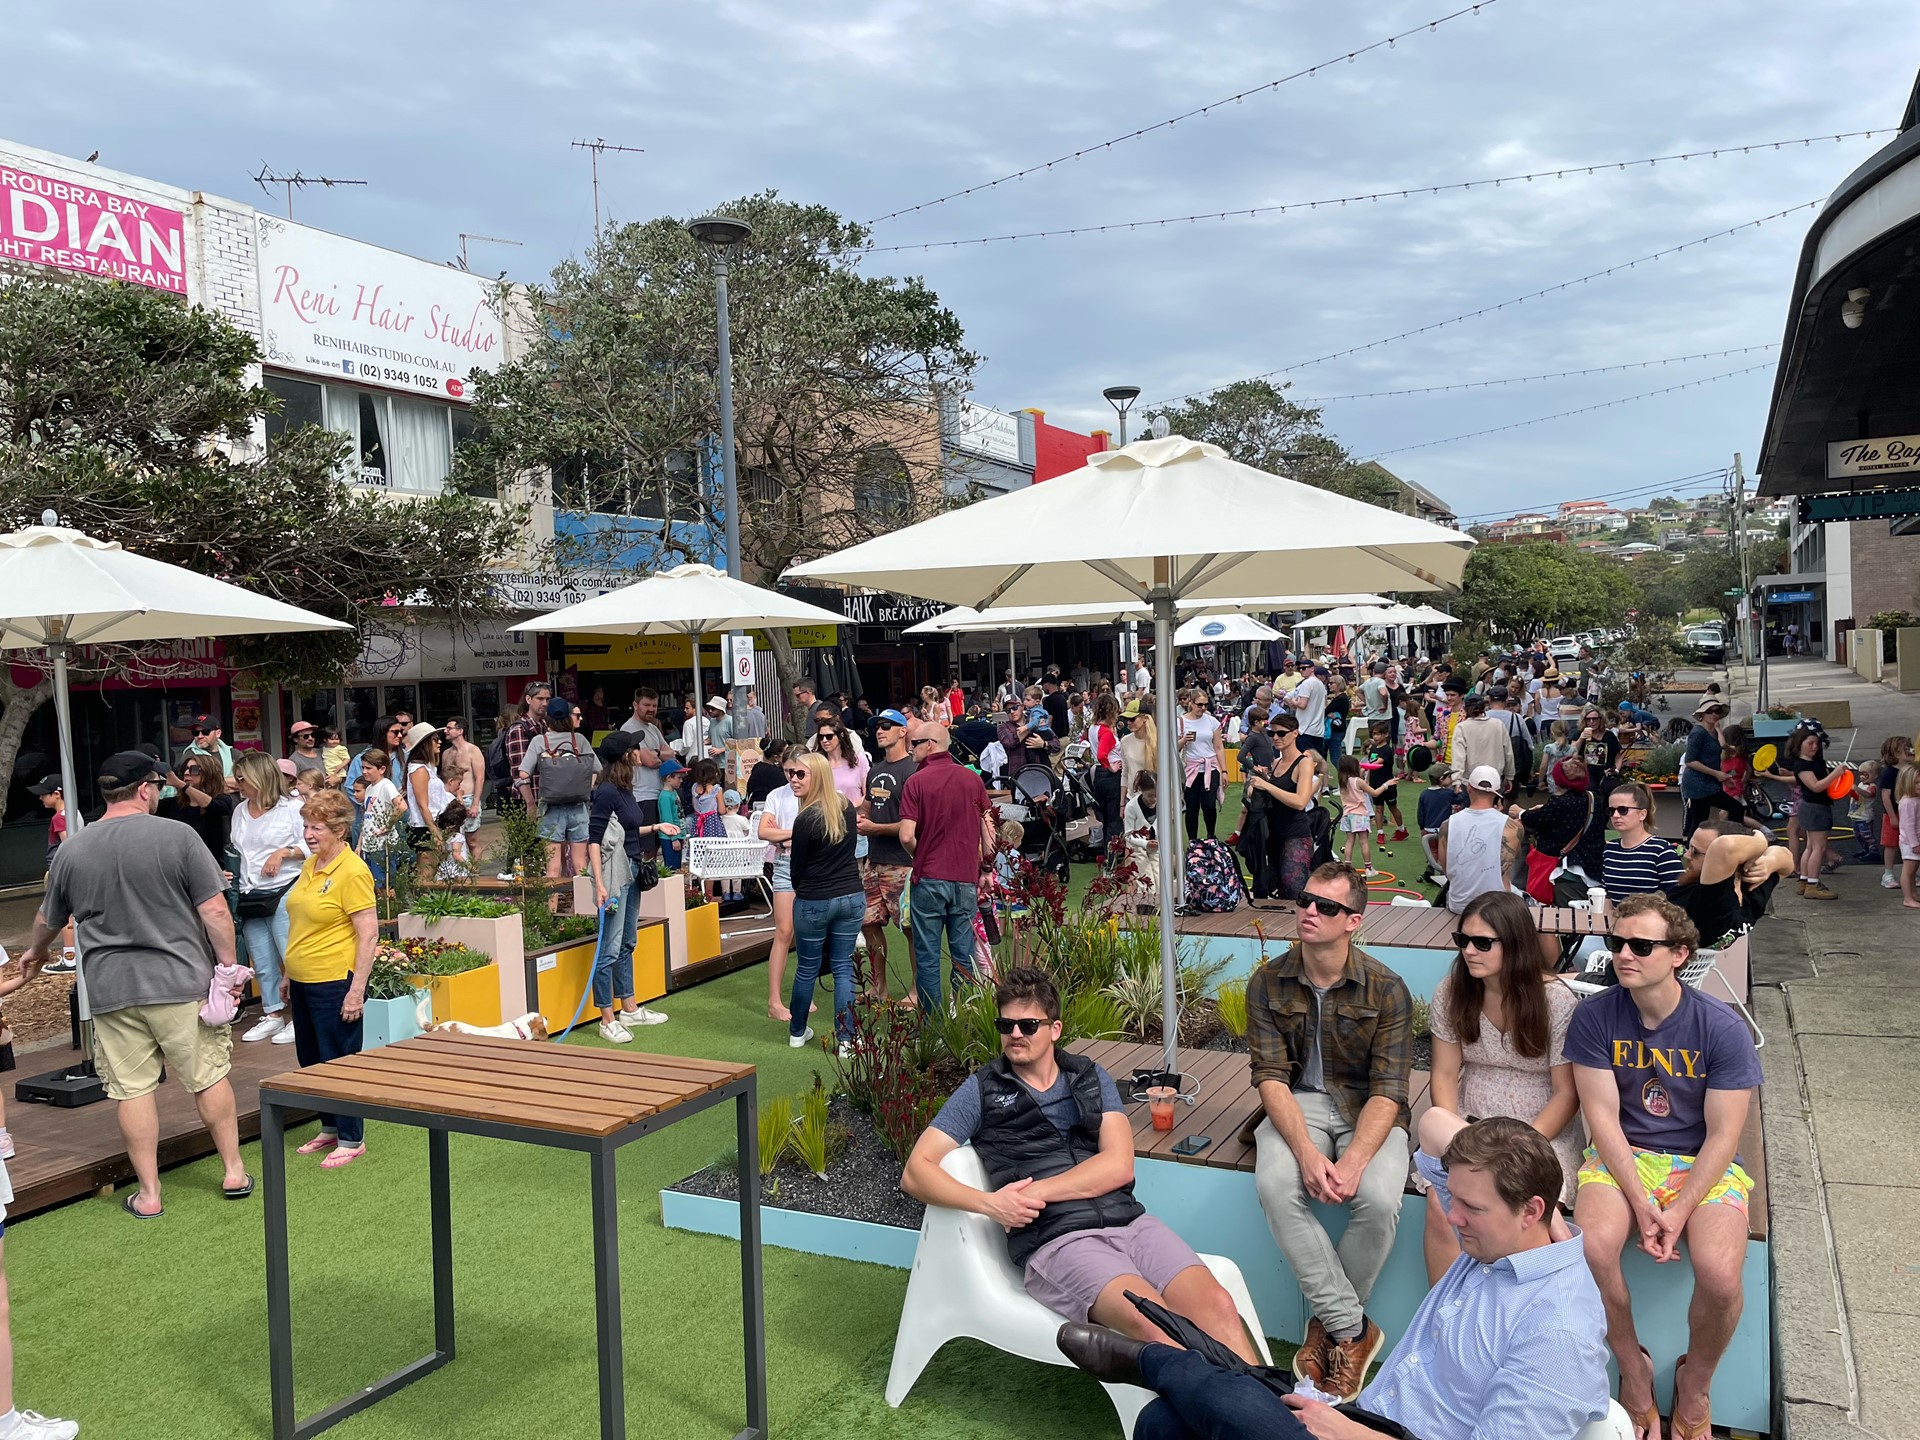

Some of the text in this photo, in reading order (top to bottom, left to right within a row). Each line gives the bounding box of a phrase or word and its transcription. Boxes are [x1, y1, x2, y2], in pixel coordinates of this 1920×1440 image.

[0, 168, 150, 220] ROUBRA BAY
[0, 188, 182, 273] DIAN
[0, 239, 183, 290] HT RESTAURANT
[273, 265, 498, 353] Reni Hair Studio
[313, 333, 456, 374] RENIHAIRSTUDIO.COM.AU
[305, 355, 321, 366] Like
[322, 358, 331, 367] us
[331, 361, 341, 369] on
[359, 363, 381, 380] (02)
[384, 367, 410, 384] 9349
[413, 373, 438, 389] 1052
[1840, 440, 1920, 466] The Bay
[1839, 496, 1885, 515] VIP
[514, 590, 587, 605] (02) 9349 1052
[879, 604, 946, 622] BREAKFAST
[798, 628, 827, 640] JUICY
[624, 641, 648, 654] FRESH
[660, 641, 682, 653] JUICY
[483, 661, 496, 670] (02)
[497, 660, 513, 668] 9349
